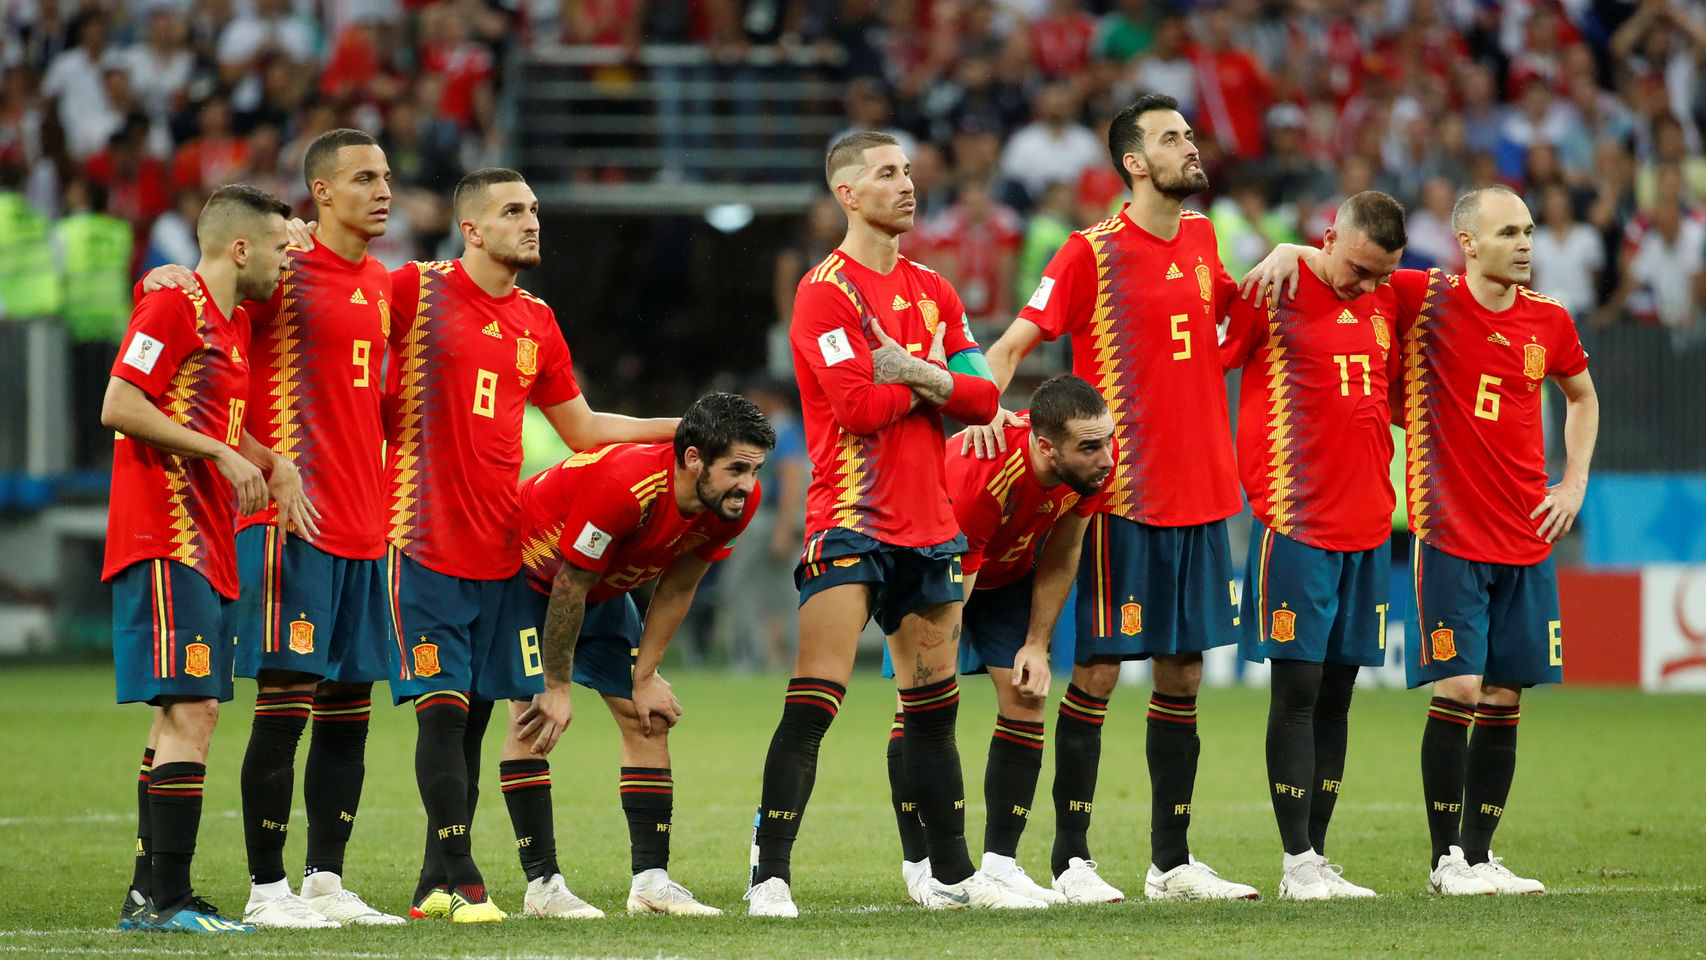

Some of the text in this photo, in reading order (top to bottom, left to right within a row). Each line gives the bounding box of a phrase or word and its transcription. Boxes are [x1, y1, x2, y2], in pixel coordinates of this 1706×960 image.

[1170, 313, 1192, 361] 5
[353, 339, 372, 388] 9
[1333, 354, 1371, 397] 17
[472, 368, 499, 419] 8
[1473, 373, 1503, 422] 6
[226, 397, 246, 447] 18
[998, 532, 1034, 563] 2
[519, 626, 544, 677] 8
